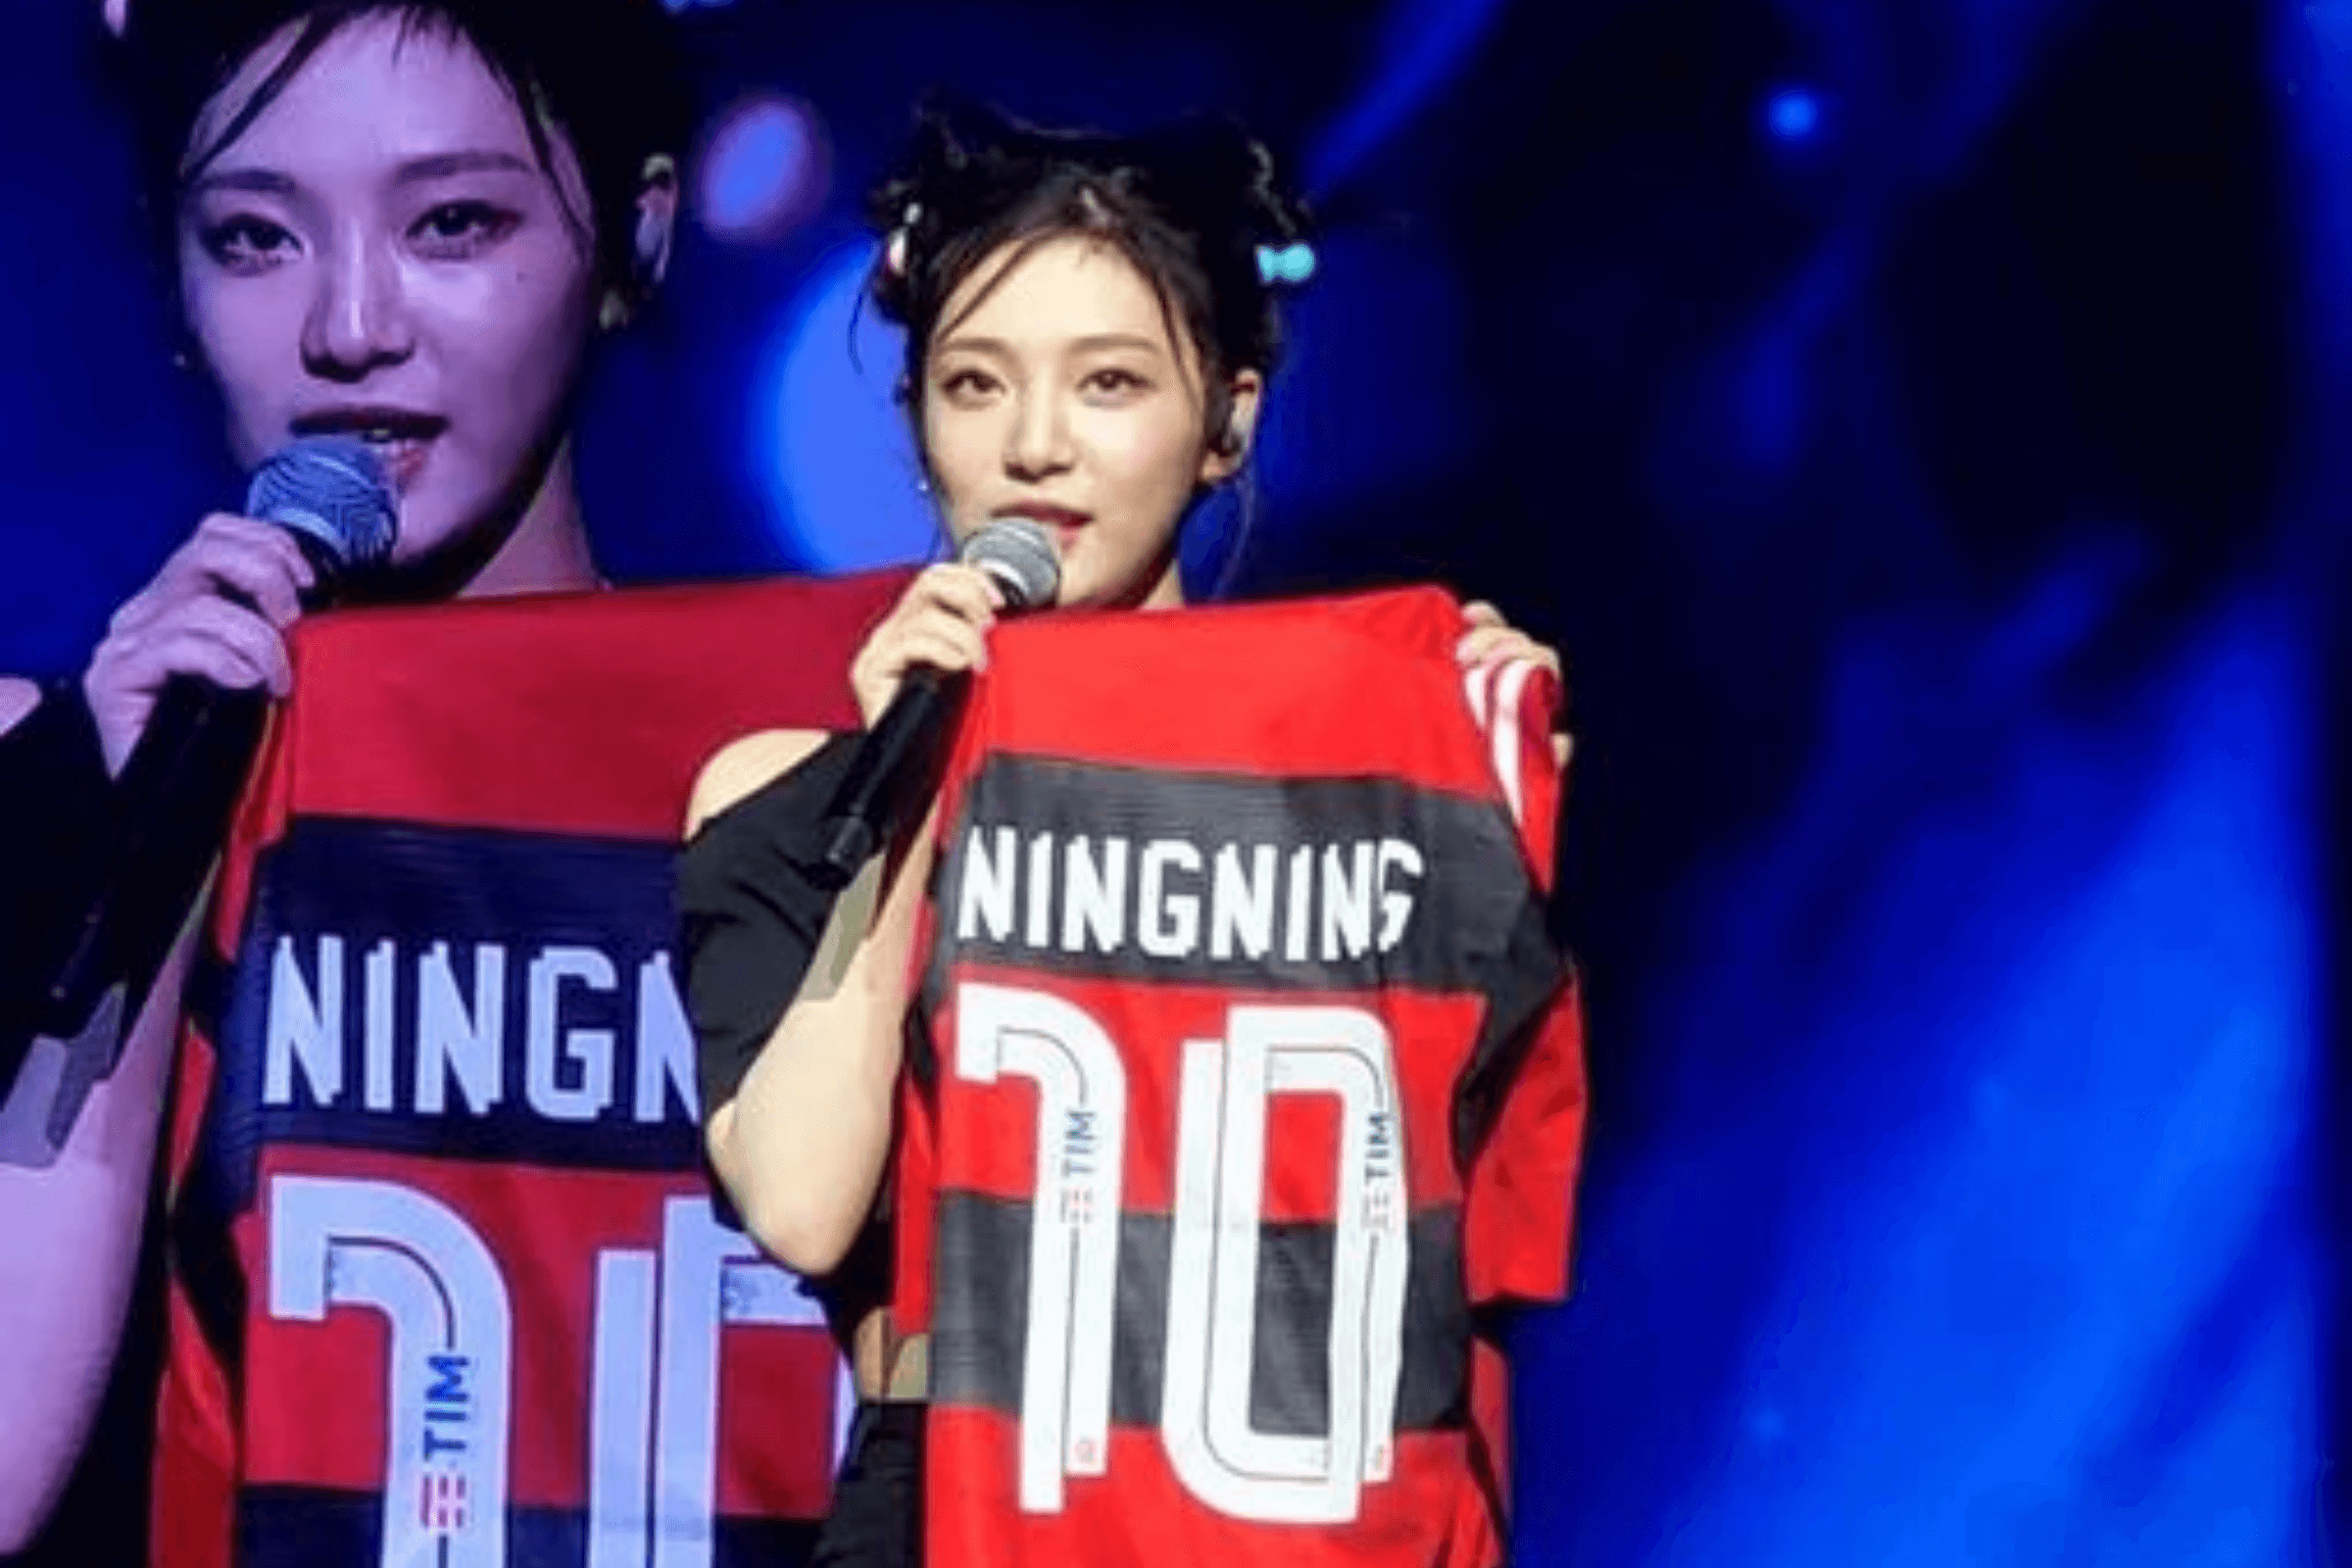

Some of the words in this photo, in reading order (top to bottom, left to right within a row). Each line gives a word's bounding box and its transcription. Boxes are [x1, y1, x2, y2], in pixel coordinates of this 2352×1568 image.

[957, 825, 1424, 961] NINGNING
[1061, 1109, 1098, 1179] TIM
[1363, 1110, 1393, 1187] TIM
[955, 982, 1408, 1525] 10
[422, 1353, 469, 1462] TIM
